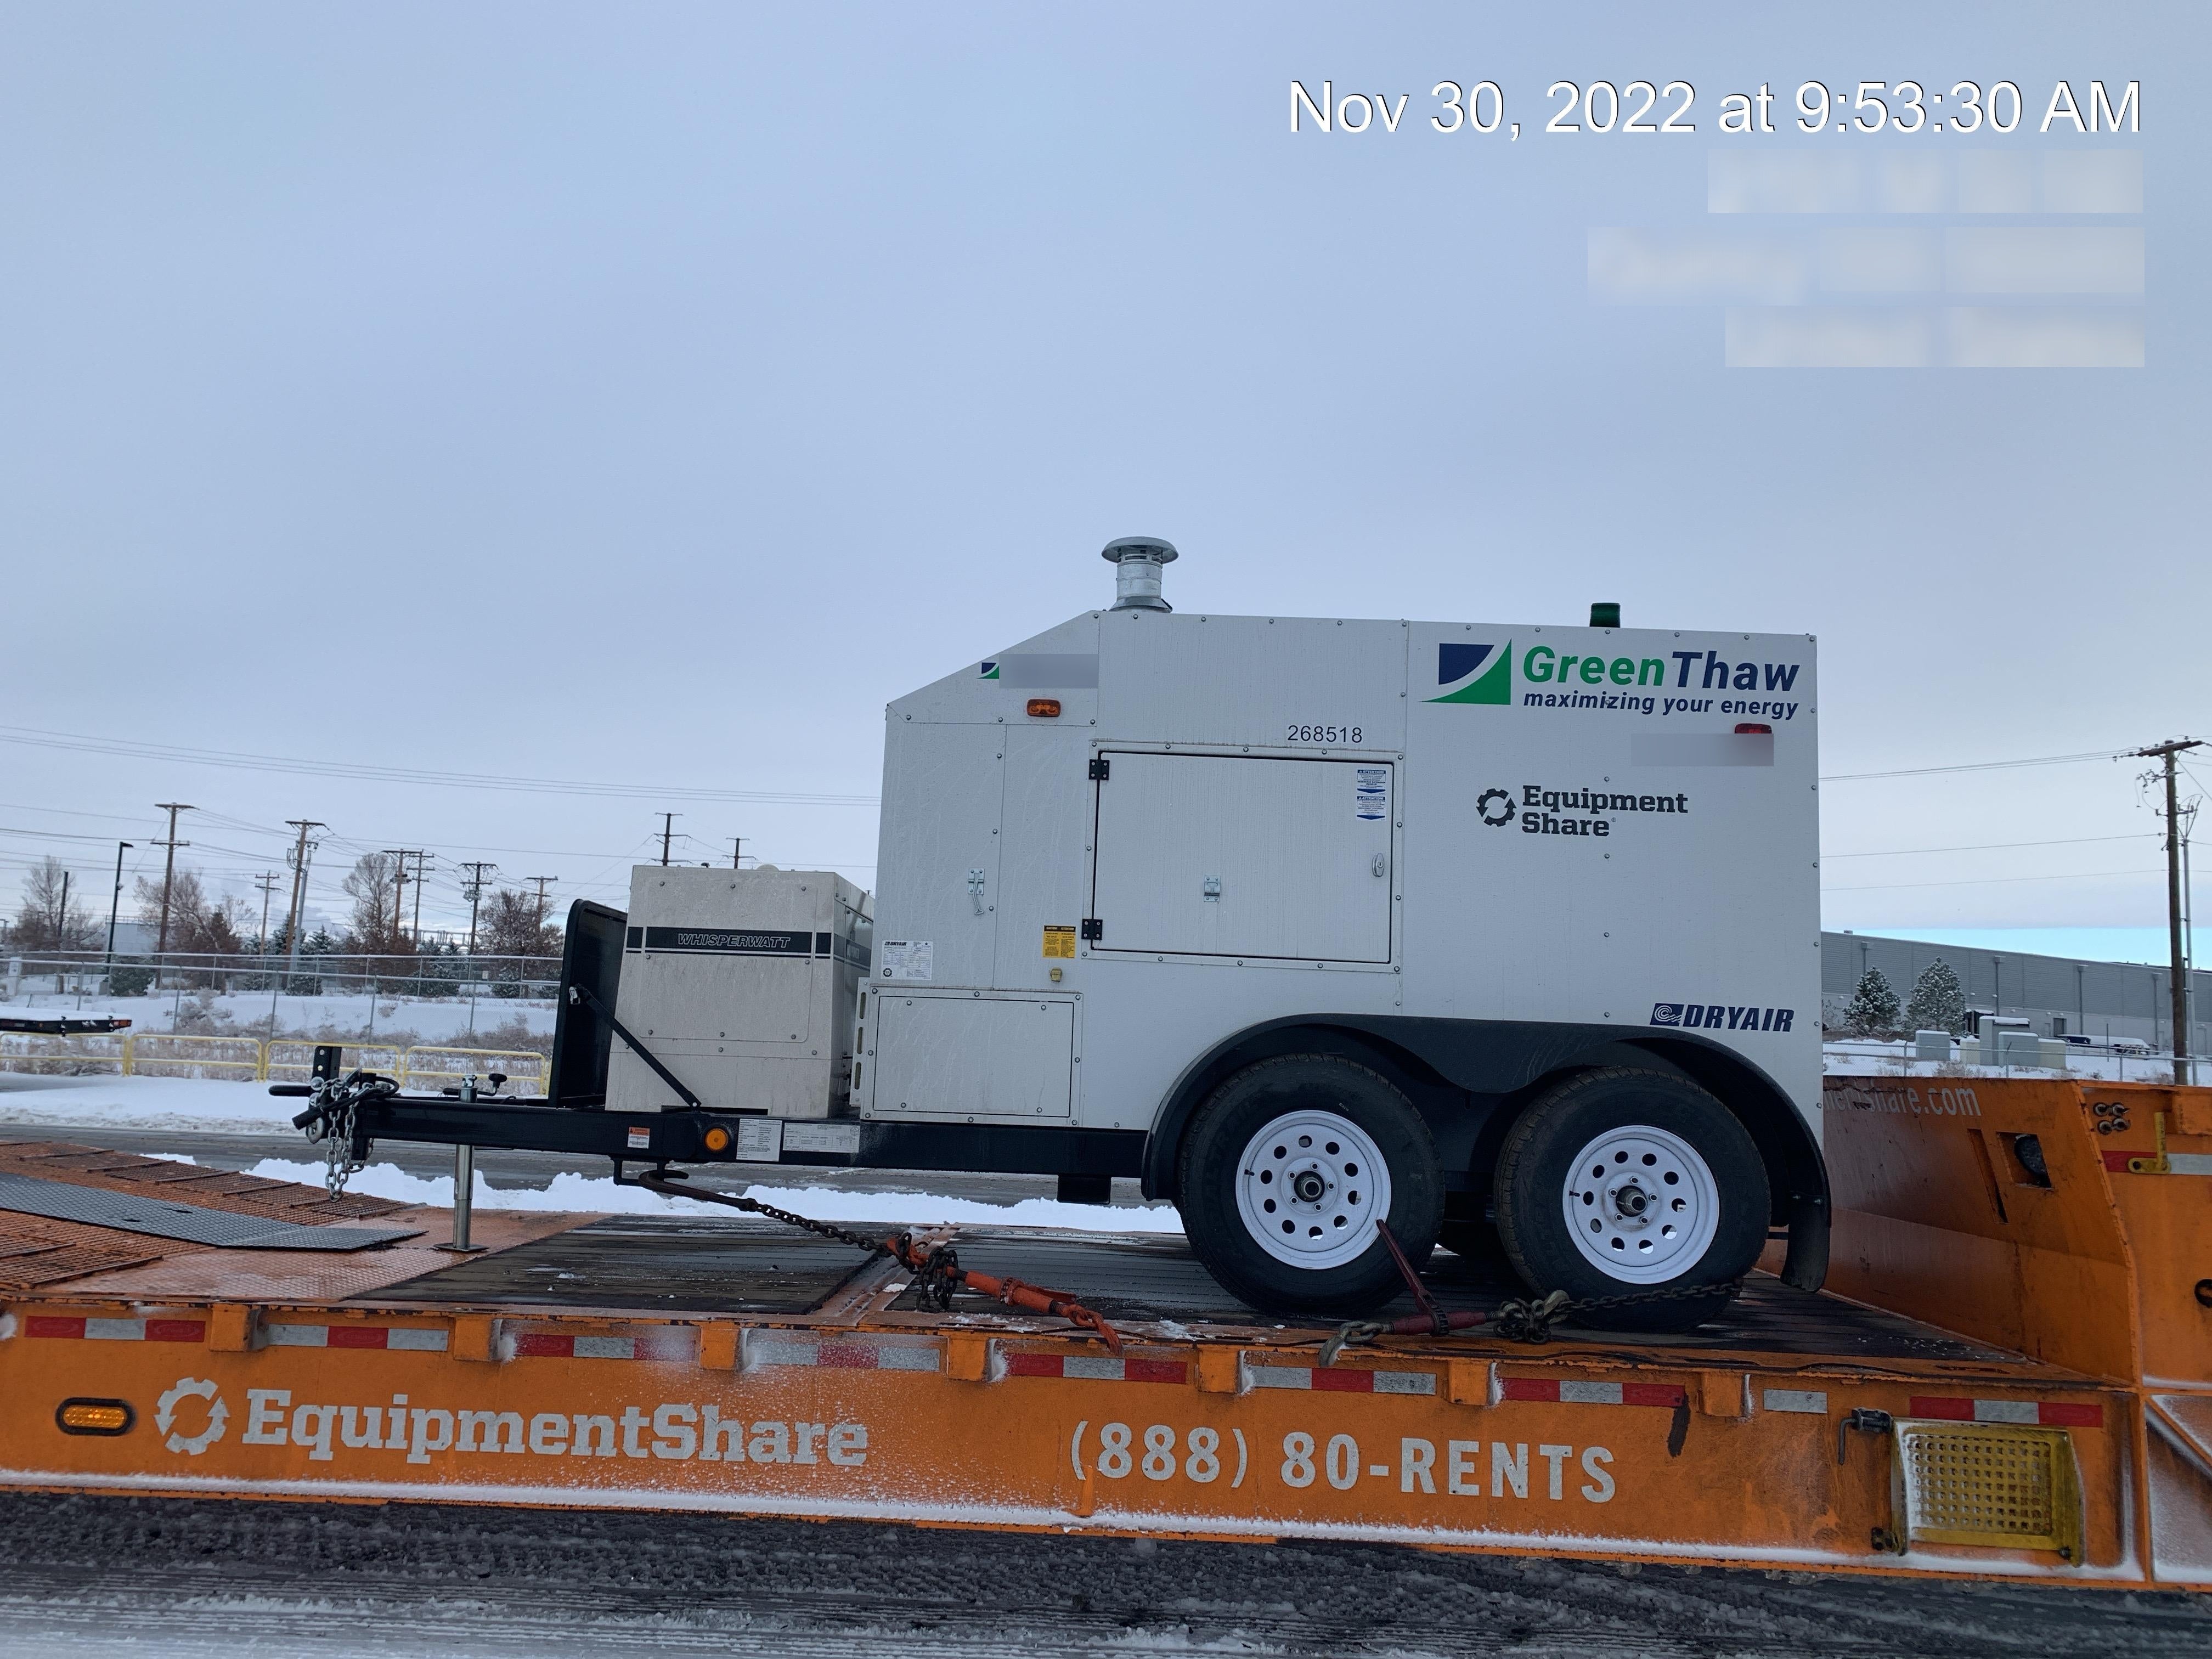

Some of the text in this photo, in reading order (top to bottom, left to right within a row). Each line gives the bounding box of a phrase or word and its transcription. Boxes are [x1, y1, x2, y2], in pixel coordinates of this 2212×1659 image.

[1523, 690, 1799, 721] maximizing your energy
[1286, 724, 1363, 744] 268518
[1522, 785, 1689, 815] Equipment
[1522, 811, 1610, 837] Share
[678, 933, 791, 949] WHISPERWATT
[1682, 1003, 1795, 1032] DRYAIR
[241, 1388, 869, 1469] EquipmentShare
[1070, 1420, 1616, 1504] (888) 80-RENTS
